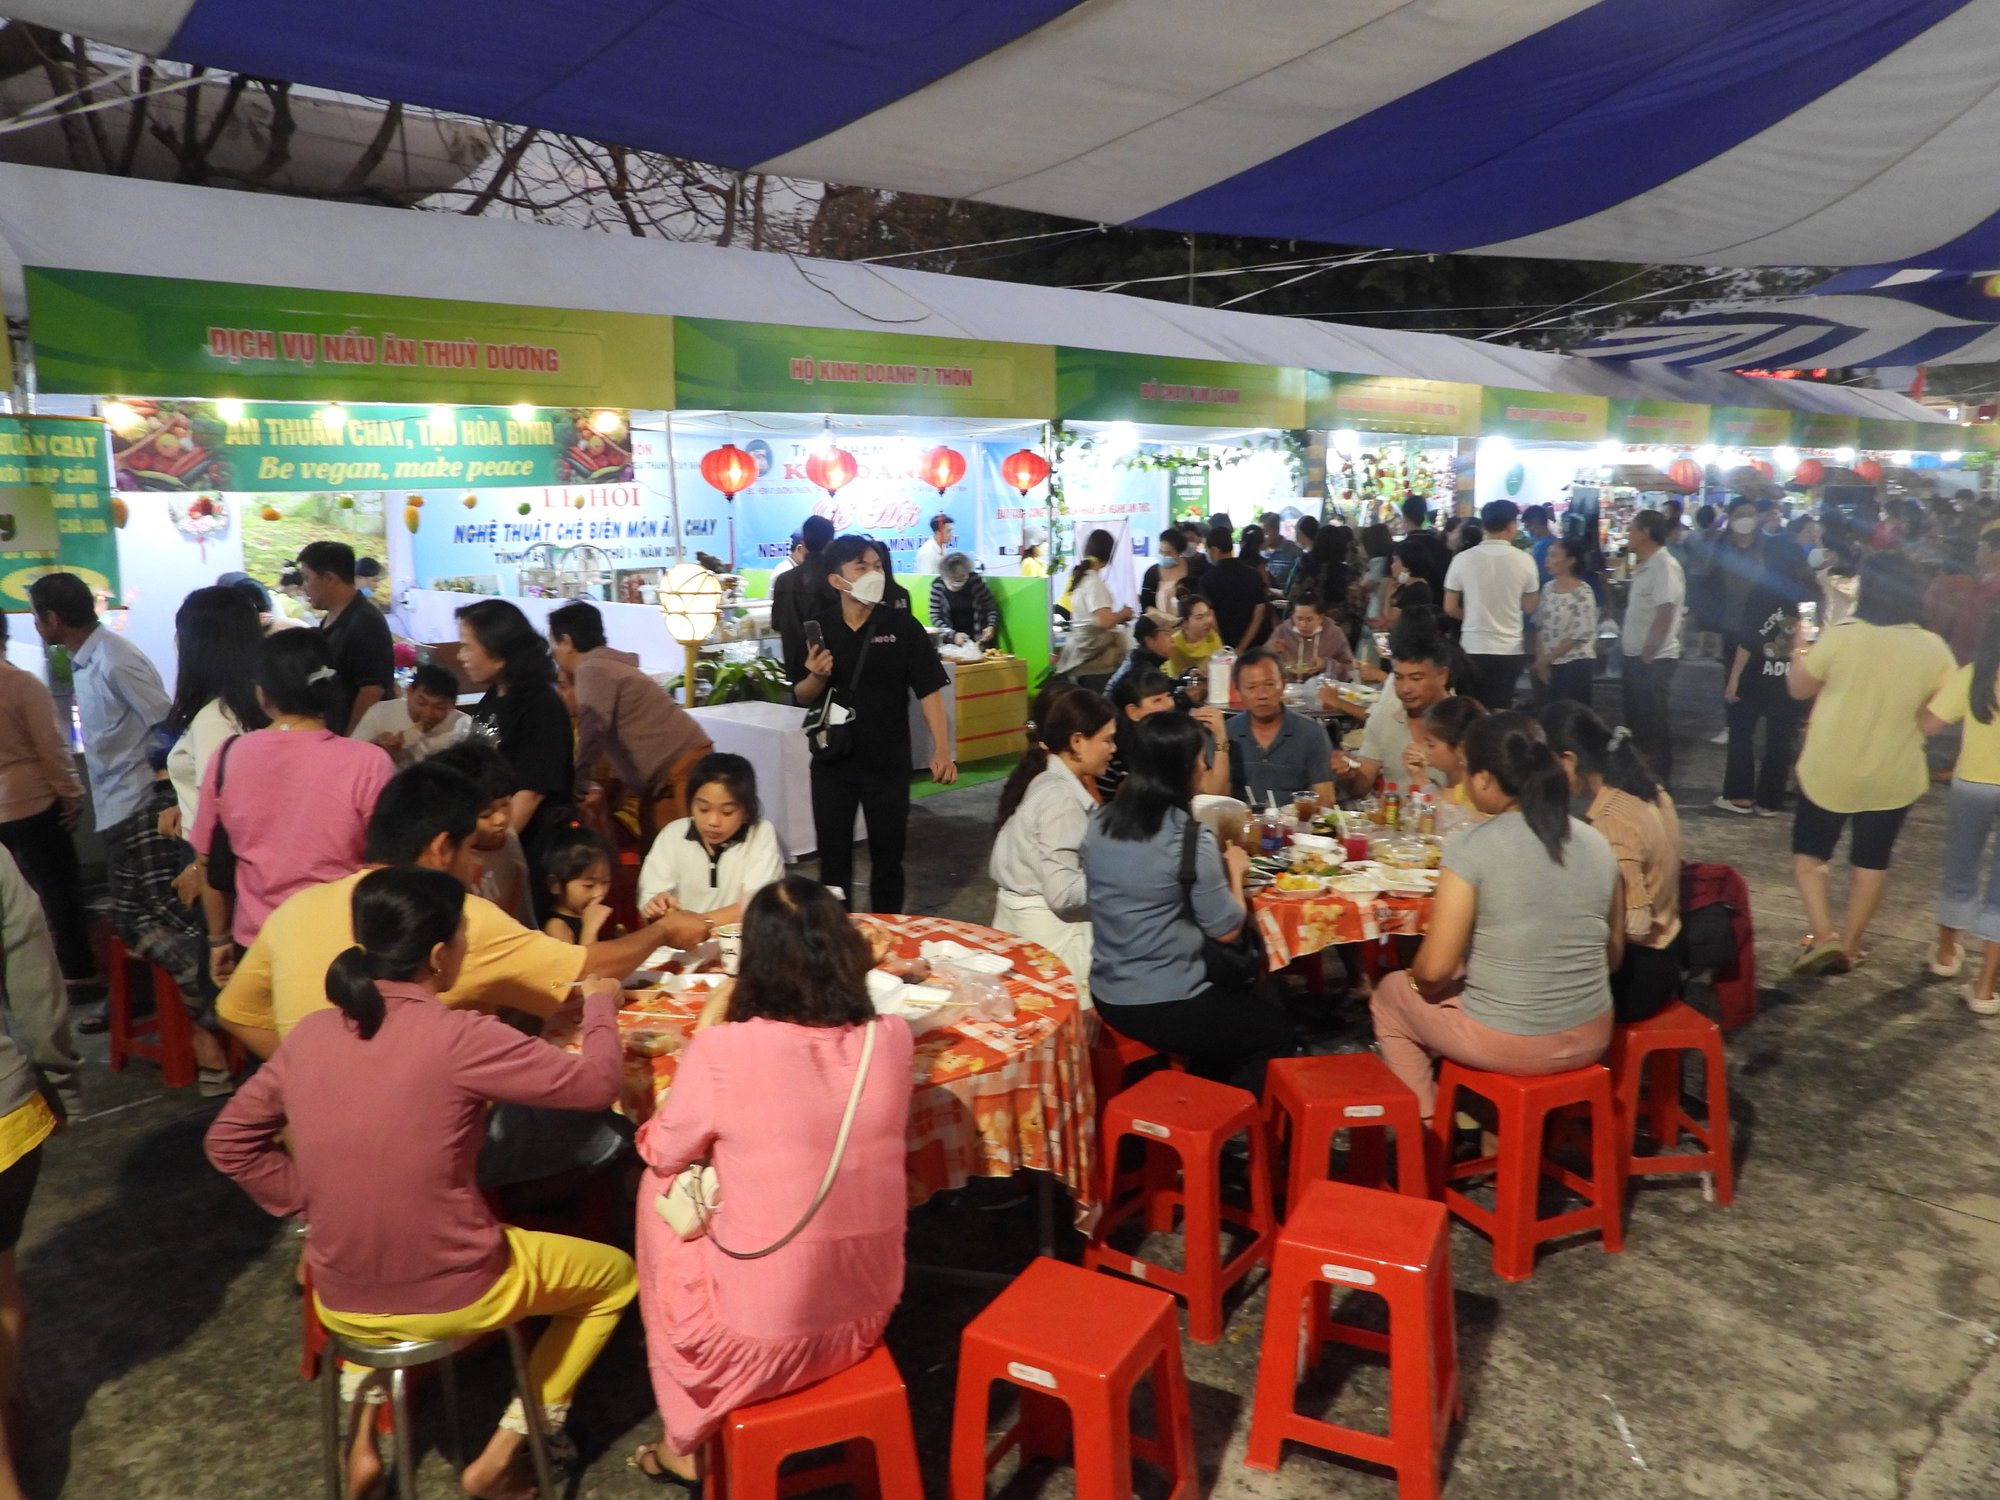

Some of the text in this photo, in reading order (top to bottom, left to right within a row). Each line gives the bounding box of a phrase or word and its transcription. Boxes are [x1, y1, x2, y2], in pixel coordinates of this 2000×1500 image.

[207, 327, 276, 365] DỊCH
[279, 331, 317, 368] VỤ
[321, 326, 376, 365] NẤU
[382, 332, 417, 367] ĂN
[790, 355, 973, 387] HỘ KINH DOANH 7 THÔN
[348, 418, 415, 450] CHAY,
[461, 414, 504, 447] HÒA
[257, 455, 535, 485] Be vegan, make peace
[684, 518, 717, 537] CHAY
